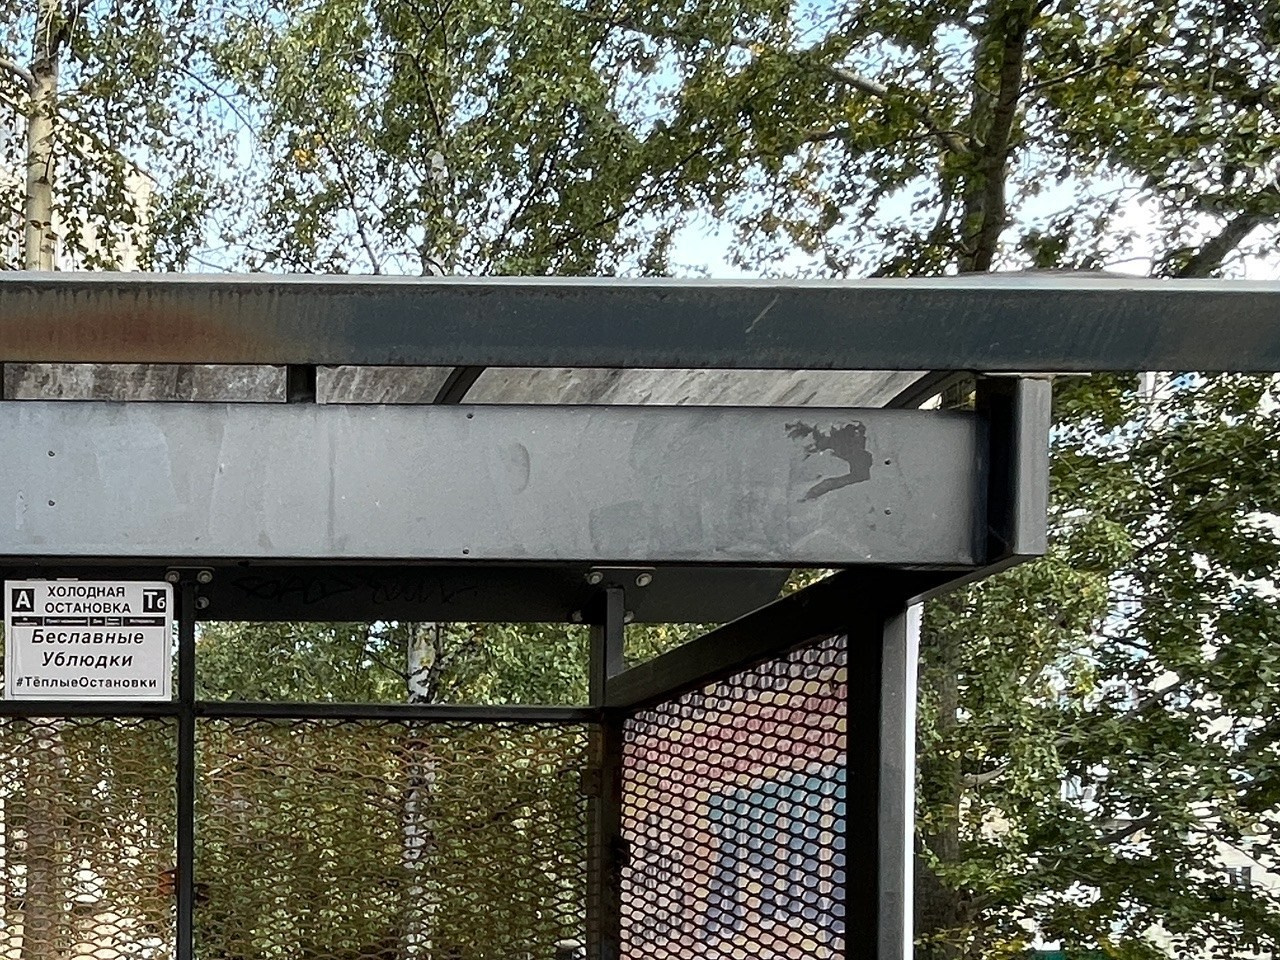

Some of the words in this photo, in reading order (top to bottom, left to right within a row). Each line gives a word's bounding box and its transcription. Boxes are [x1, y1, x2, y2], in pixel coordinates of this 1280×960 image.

[15, 590, 31, 608] А
[47, 586, 125, 599] ХОЛОДНАЯ
[44, 602, 132, 613] ОСТАНОВКА
[31, 629, 144, 644] Беславные
[42, 652, 133, 668] Ублюдки
[16, 676, 157, 688] #ТёплыеОстановки
